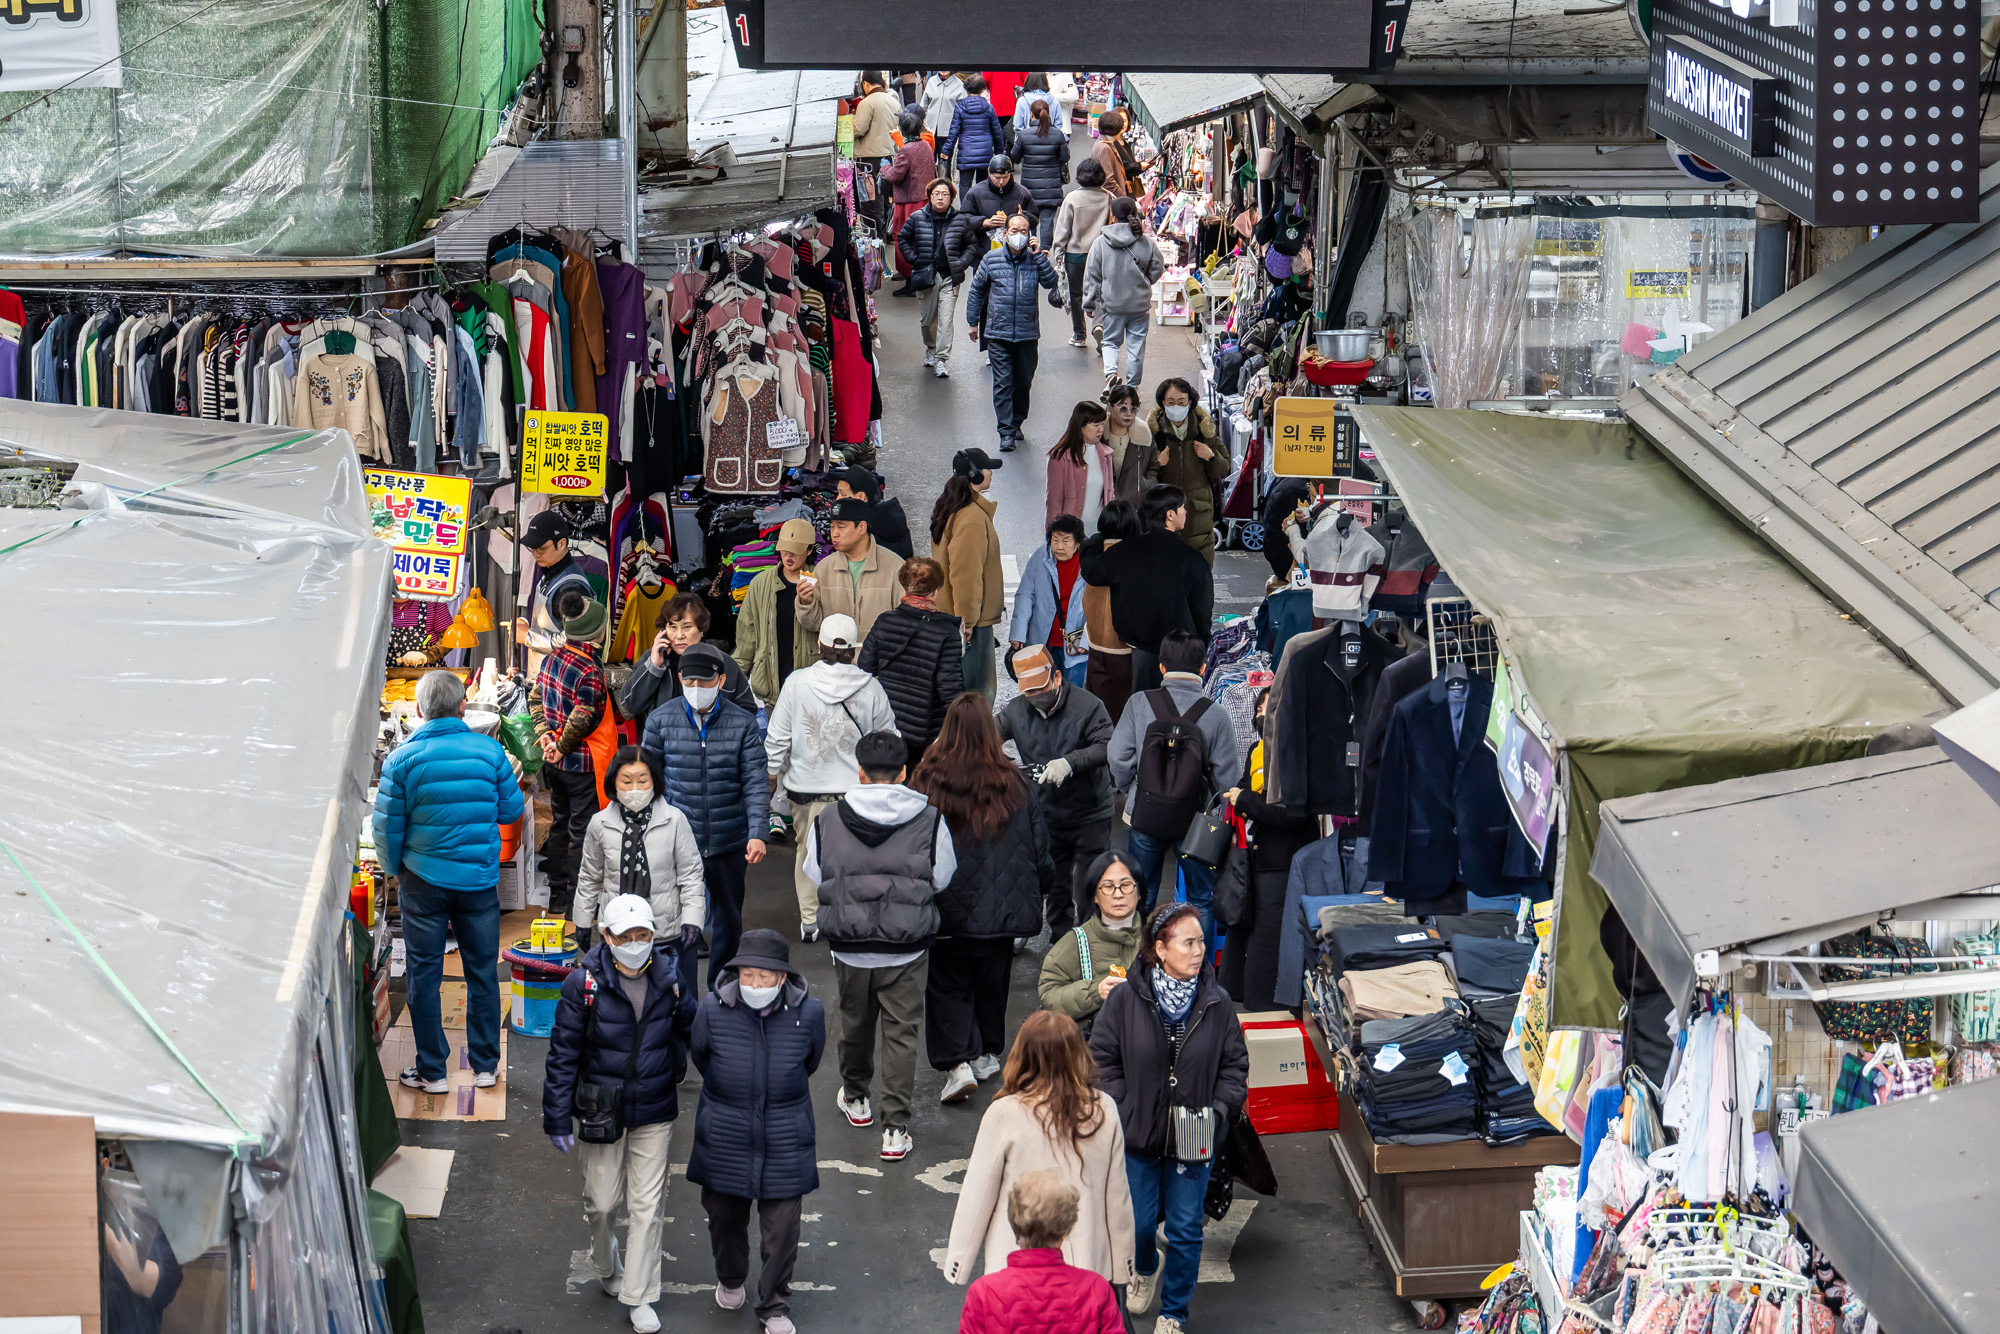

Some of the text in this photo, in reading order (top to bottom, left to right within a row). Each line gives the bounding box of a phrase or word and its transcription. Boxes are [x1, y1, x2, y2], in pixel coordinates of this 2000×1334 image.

[735, 13, 750, 47] 1
[1385, 20, 1397, 53] 1
[1666, 49, 1751, 141] DONGSAN MARKET
[545, 420, 603, 437] 찹쌀씨앗 호떡
[524, 437, 537, 475] 먹거리
[544, 437, 602, 452] 진짜 영양 많은
[1284, 443, 1302, 453] (남자
[543, 452, 601, 474] 씨앗 호떡
[554, 476, 587, 487] 1,000원
[385, 494, 446, 522] 납작
[403, 520, 459, 546] 만두
